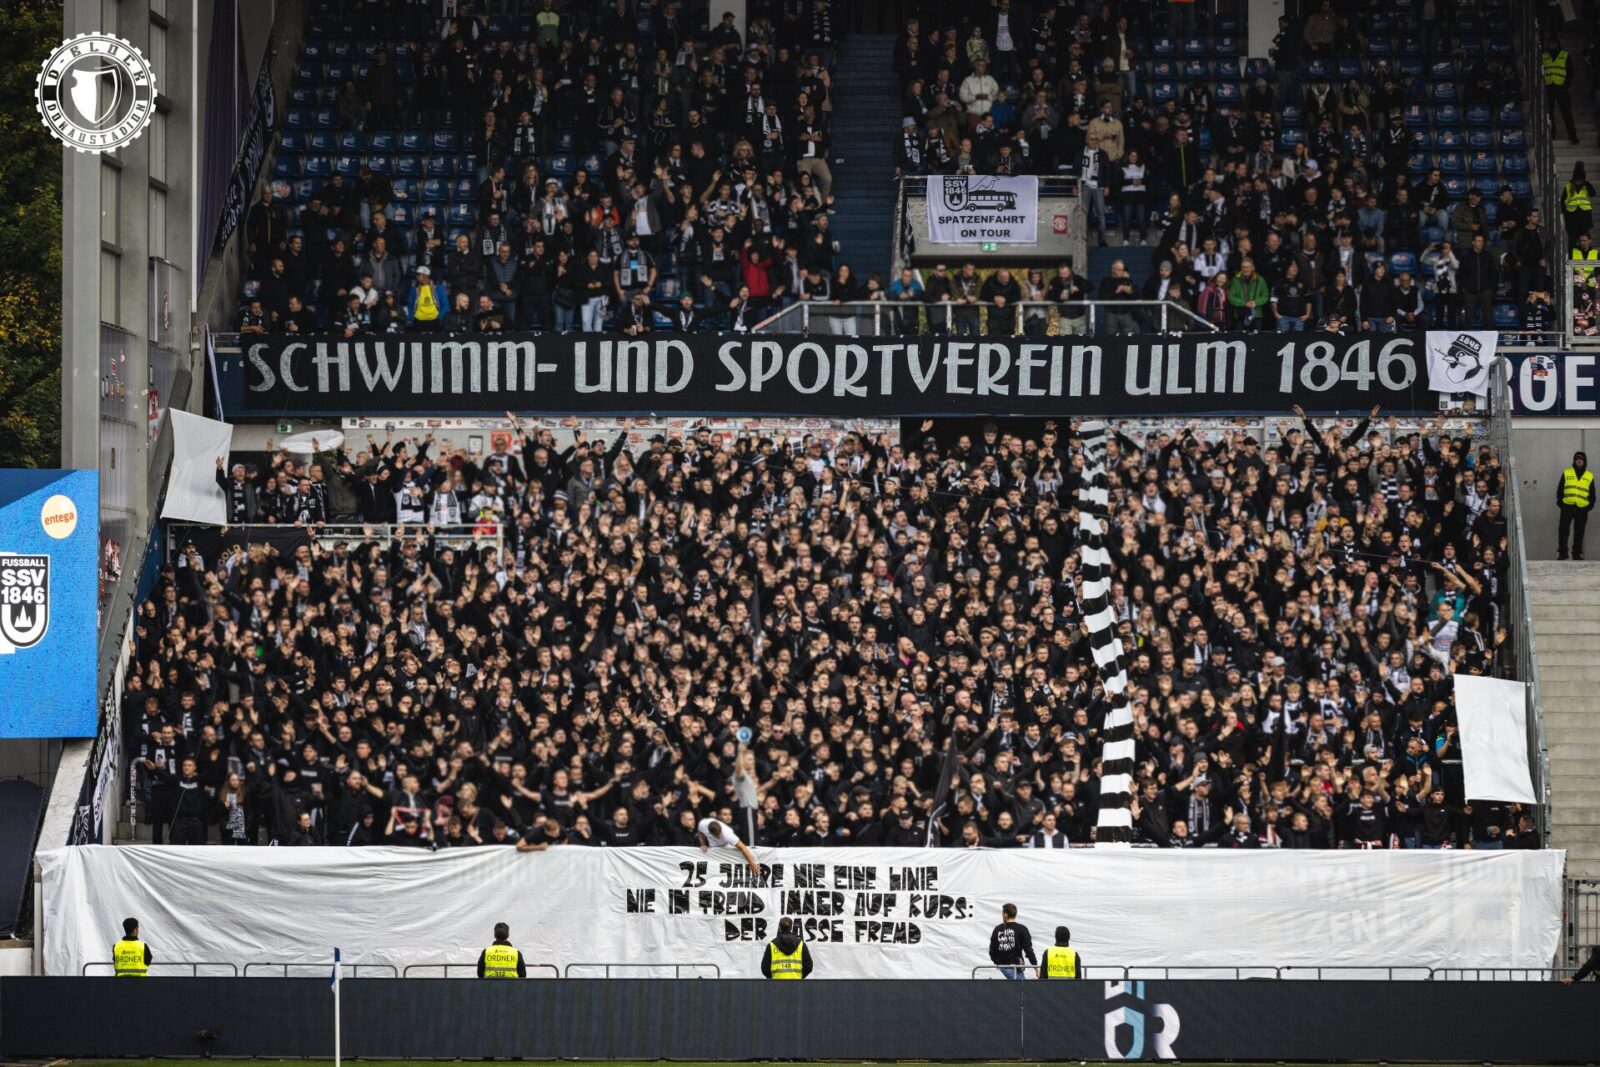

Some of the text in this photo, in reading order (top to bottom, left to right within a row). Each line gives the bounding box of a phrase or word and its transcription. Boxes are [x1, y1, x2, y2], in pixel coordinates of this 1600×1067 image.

[945, 187, 967, 195] 1846
[938, 215, 1026, 225] SPATZENFAHRT
[960, 229, 1011, 238] ON TOUR
[1459, 334, 1481, 350] 1846
[574, 338, 695, 394] UND
[714, 339, 1102, 398] SPORTVEREIN
[1123, 339, 1247, 397] ULM
[1275, 337, 1417, 395] 1846
[44, 511, 75, 526] entega
[1, 558, 46, 567] FUSSBALL
[1, 568, 46, 586] SSV
[1, 586, 45, 604] 1846
[678, 860, 708, 888] 25
[718, 862, 784, 888] JAHRE
[793, 863, 826, 889] NIE
[833, 865, 877, 890] EINE
[626, 888, 974, 920] NIE IM TREND IMMER AUF KURS:
[724, 917, 768, 942] DER
[777, 917, 844, 943] ASSE
[486, 954, 516, 962] ORDNER
